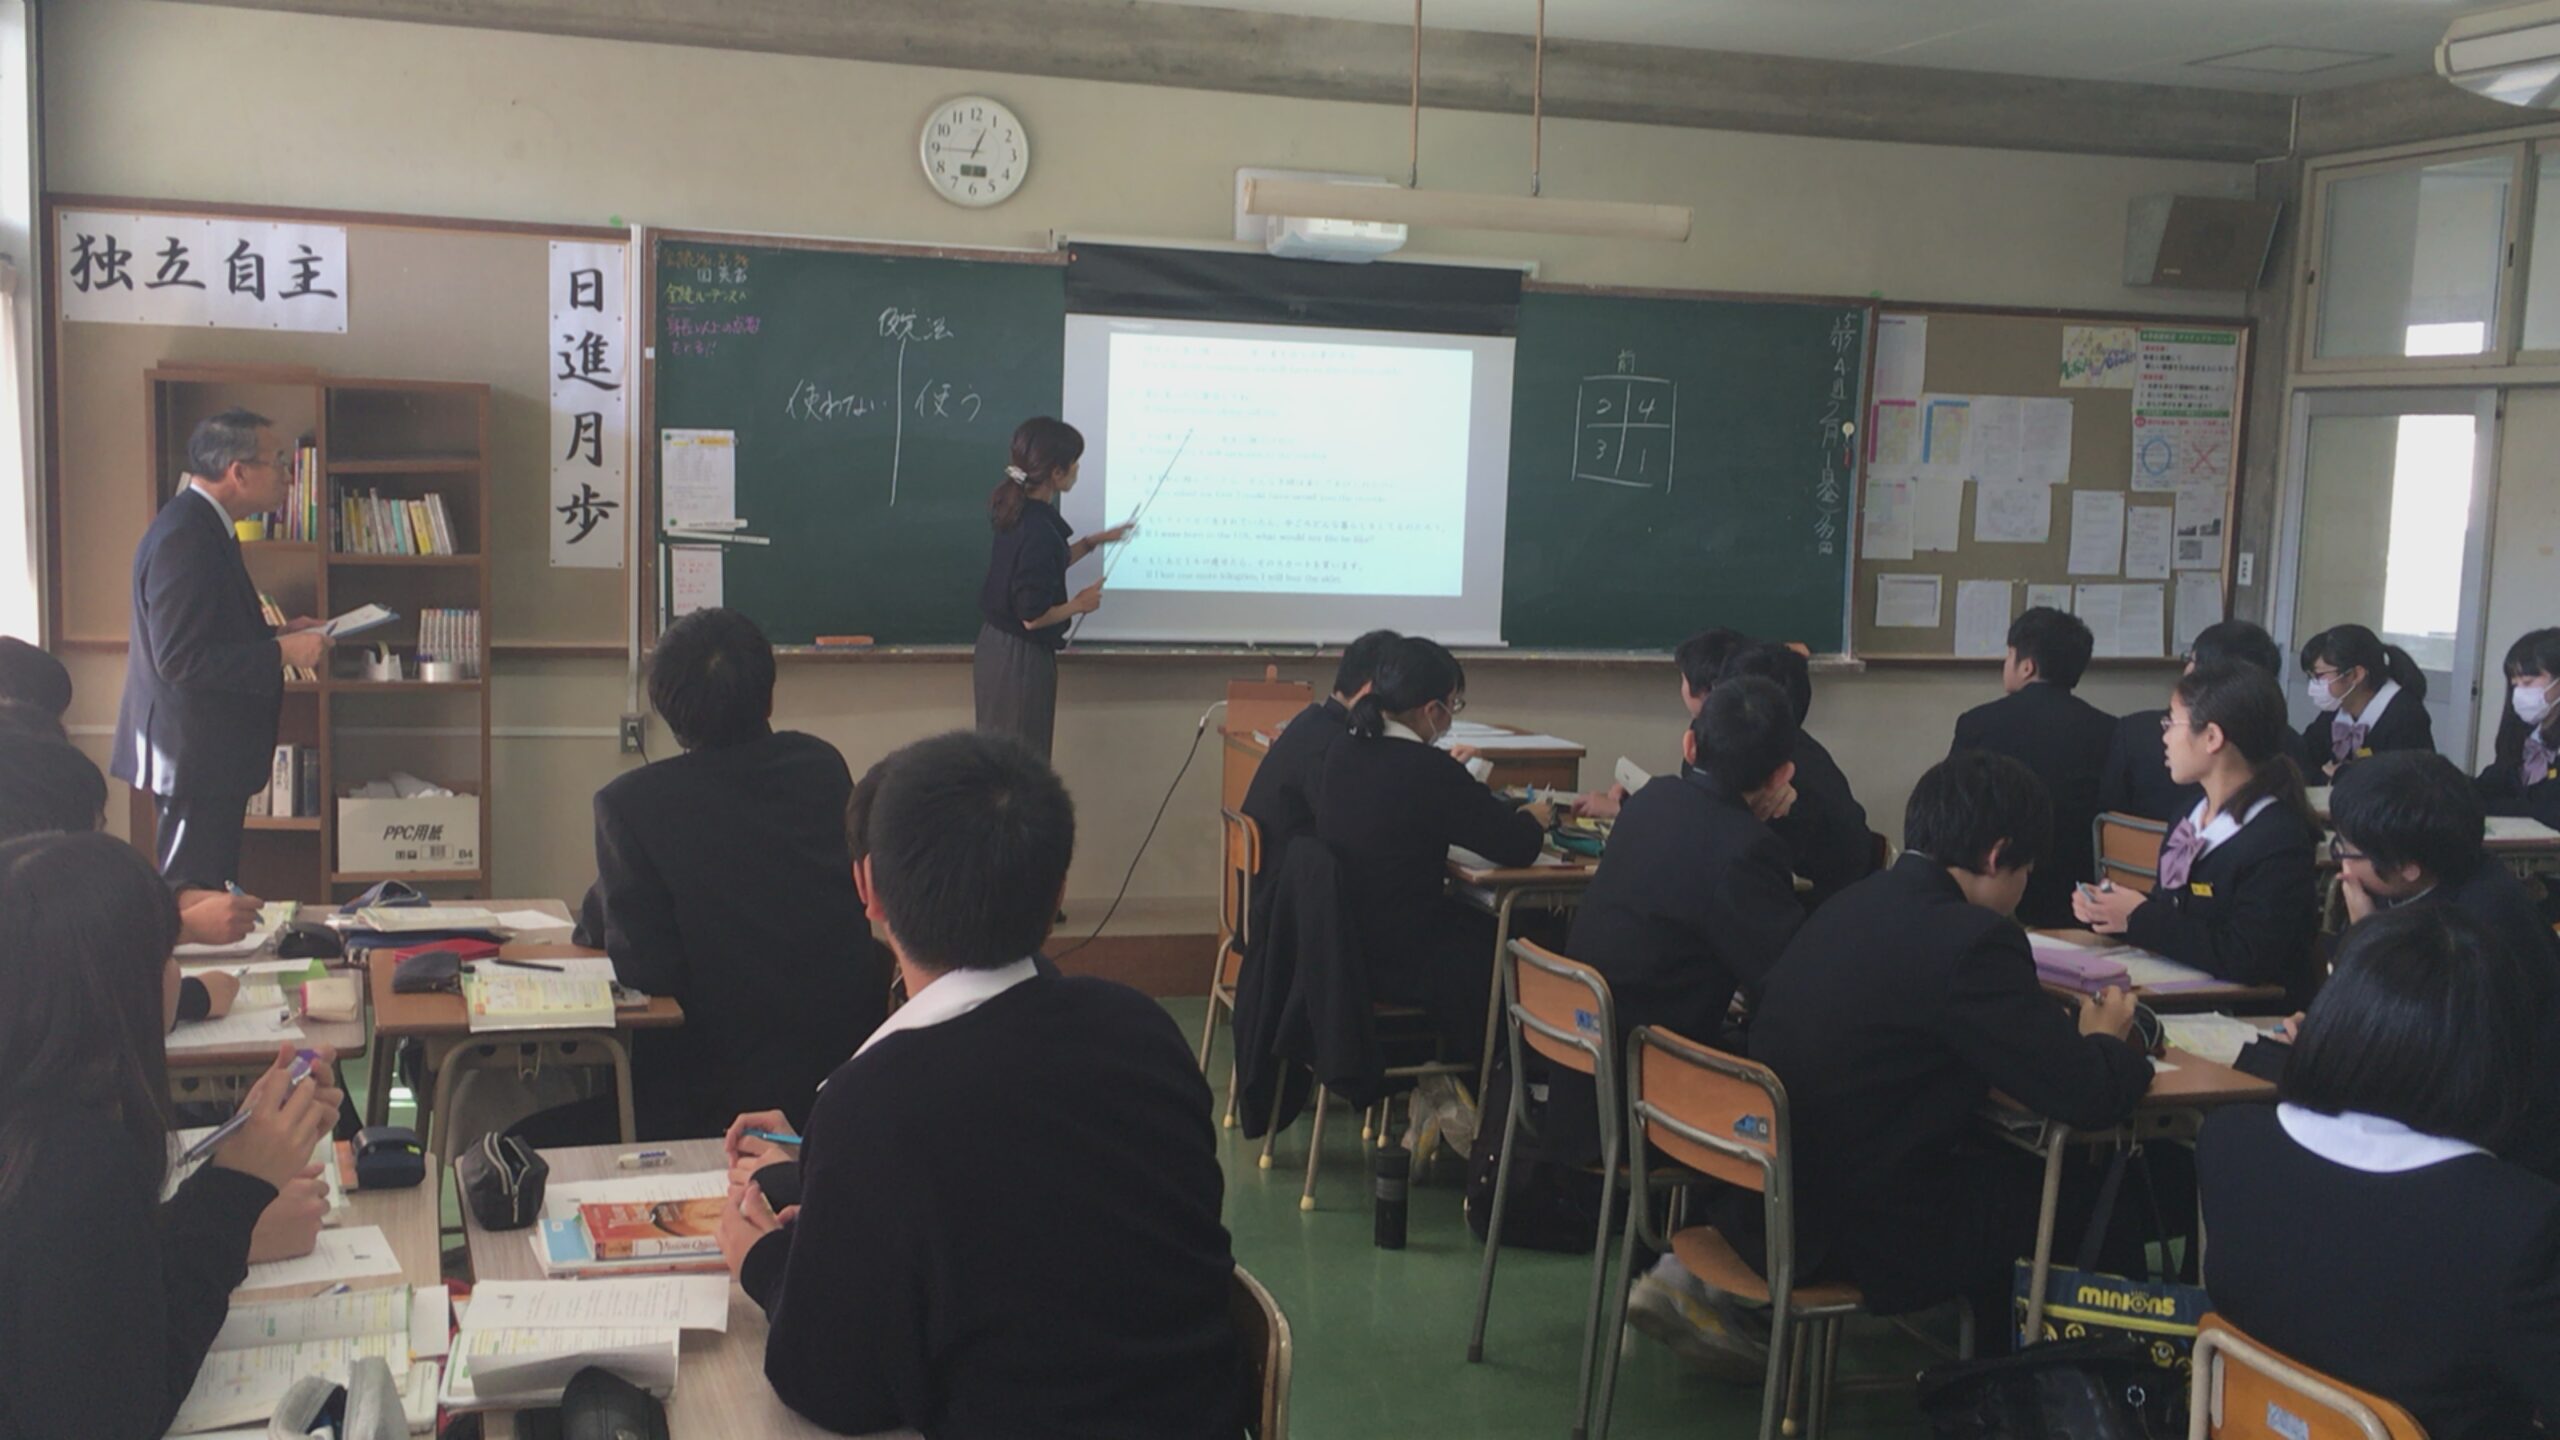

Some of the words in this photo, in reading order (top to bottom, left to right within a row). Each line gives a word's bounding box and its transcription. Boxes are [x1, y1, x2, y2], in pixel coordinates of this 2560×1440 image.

[952, 110, 964, 124] 11
[970, 107, 984, 122] 12
[992, 115, 998, 128] 1
[938, 123, 951, 137] 10
[1005, 129, 1013, 143] 2
[931, 141, 941, 154] 9
[1011, 148, 1018, 162] 3
[936, 161, 946, 174] 8
[1002, 168, 1010, 181] 4
[951, 175, 959, 189] 7
[968, 182, 978, 196] 6
[987, 179, 997, 193] 5
[70, 231, 338, 302] 独立自主
[556, 267, 622, 545] 日進月歩
[784, 378, 889, 422] 使わない
[914, 378, 983, 423] 使う
[1595, 397, 1613, 416] 2
[1637, 396, 1657, 425] 4
[1595, 438, 1608, 461] 3
[1638, 447, 1648, 474] 1
[383, 823, 444, 842] PPC用紙
[458, 848, 473, 859] B4
